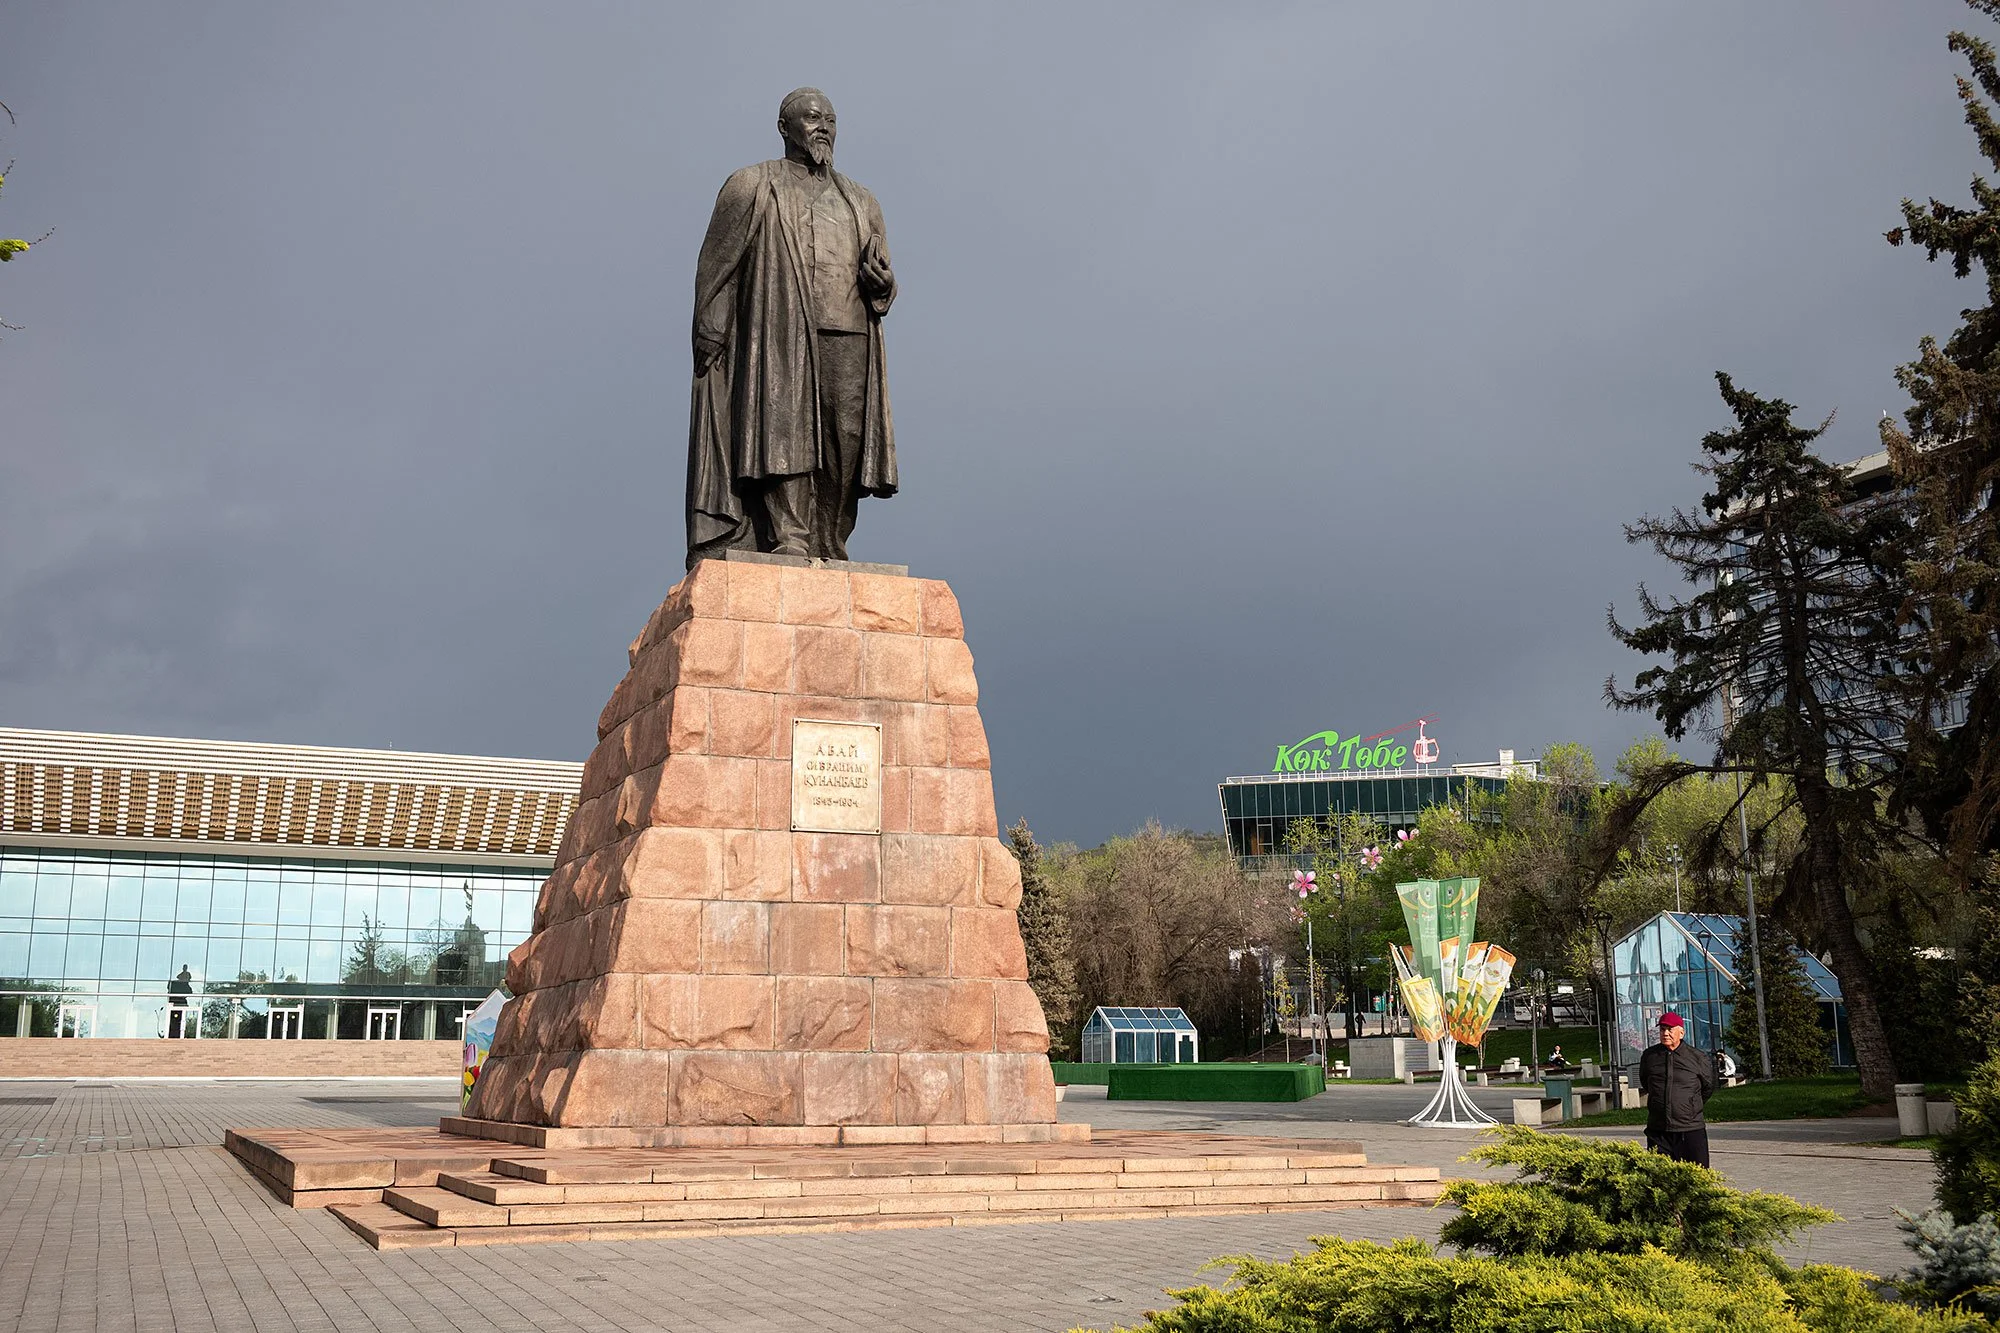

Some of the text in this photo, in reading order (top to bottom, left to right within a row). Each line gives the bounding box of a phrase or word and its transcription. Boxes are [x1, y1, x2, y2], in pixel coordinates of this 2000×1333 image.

[815, 744, 858, 758] АБАЙ
[1272, 731, 1407, 772] Көк Төбе
